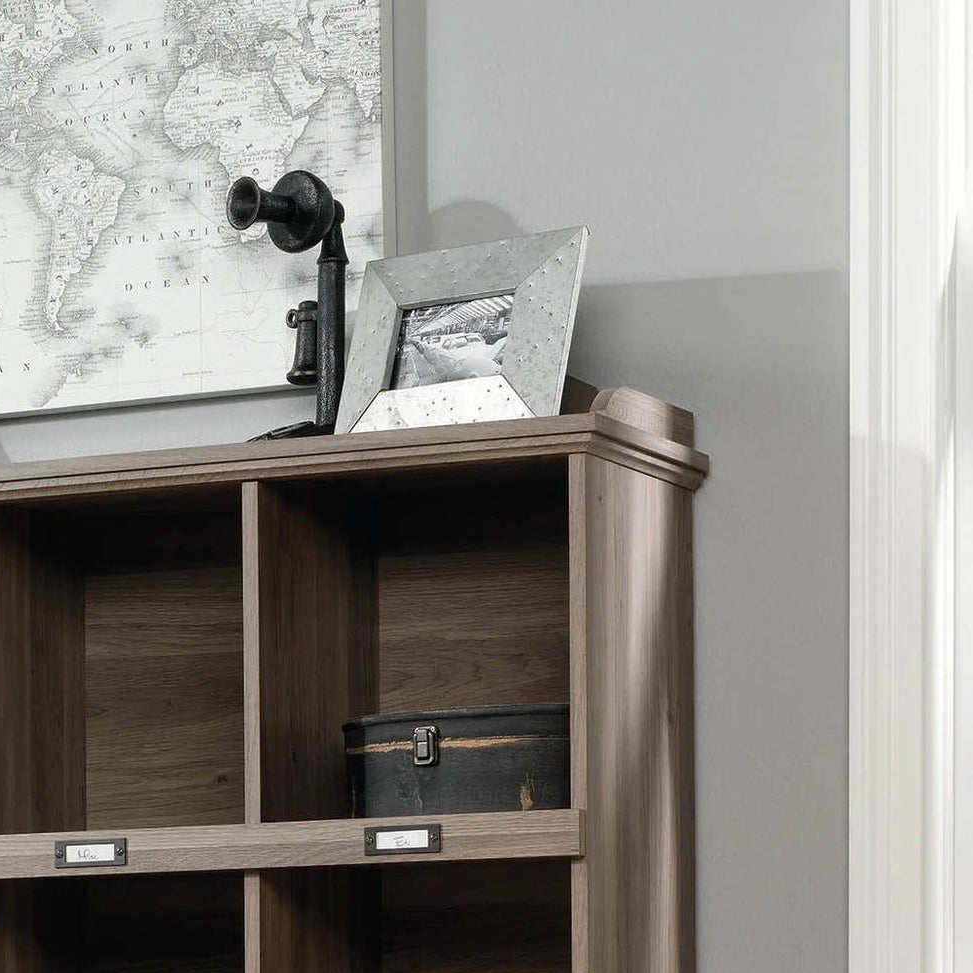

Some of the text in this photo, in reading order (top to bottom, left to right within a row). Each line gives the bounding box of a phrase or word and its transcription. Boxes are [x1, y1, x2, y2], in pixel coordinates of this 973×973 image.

[92, 38, 169, 56] NORTH
[50, 73, 166, 95] ATLANTIC
[64, 108, 148, 127] OCEAN
[133, 179, 213, 198] SOUTH
[112, 225, 224, 246] ATLANTIC
[124, 274, 211, 293] OCEAN
